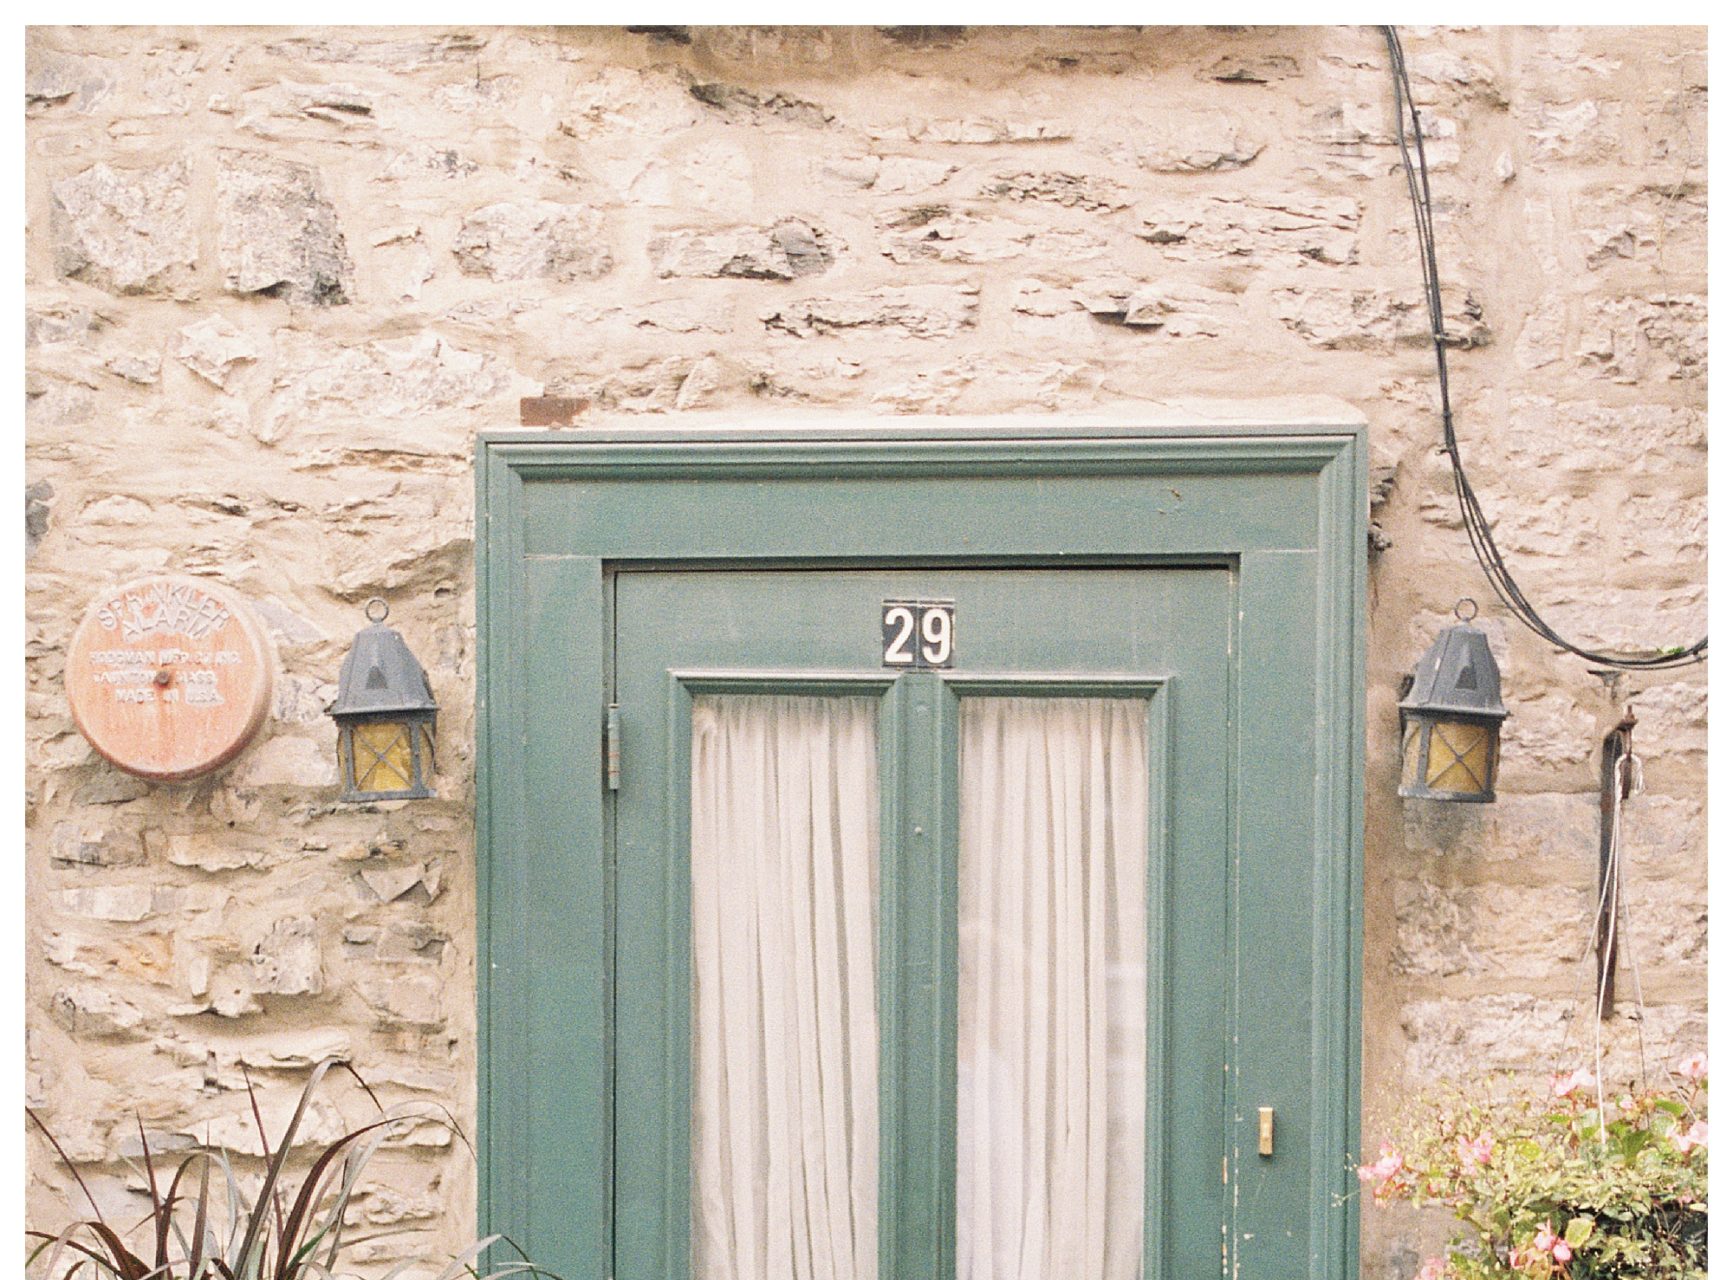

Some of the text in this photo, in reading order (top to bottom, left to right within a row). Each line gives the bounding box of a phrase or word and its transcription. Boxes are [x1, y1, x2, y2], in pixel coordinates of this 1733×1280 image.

[97, 583, 229, 630] SPRINKLER
[122, 609, 210, 642] ALARM
[884, 607, 951, 664] 29
[115, 689, 155, 703] MADE
